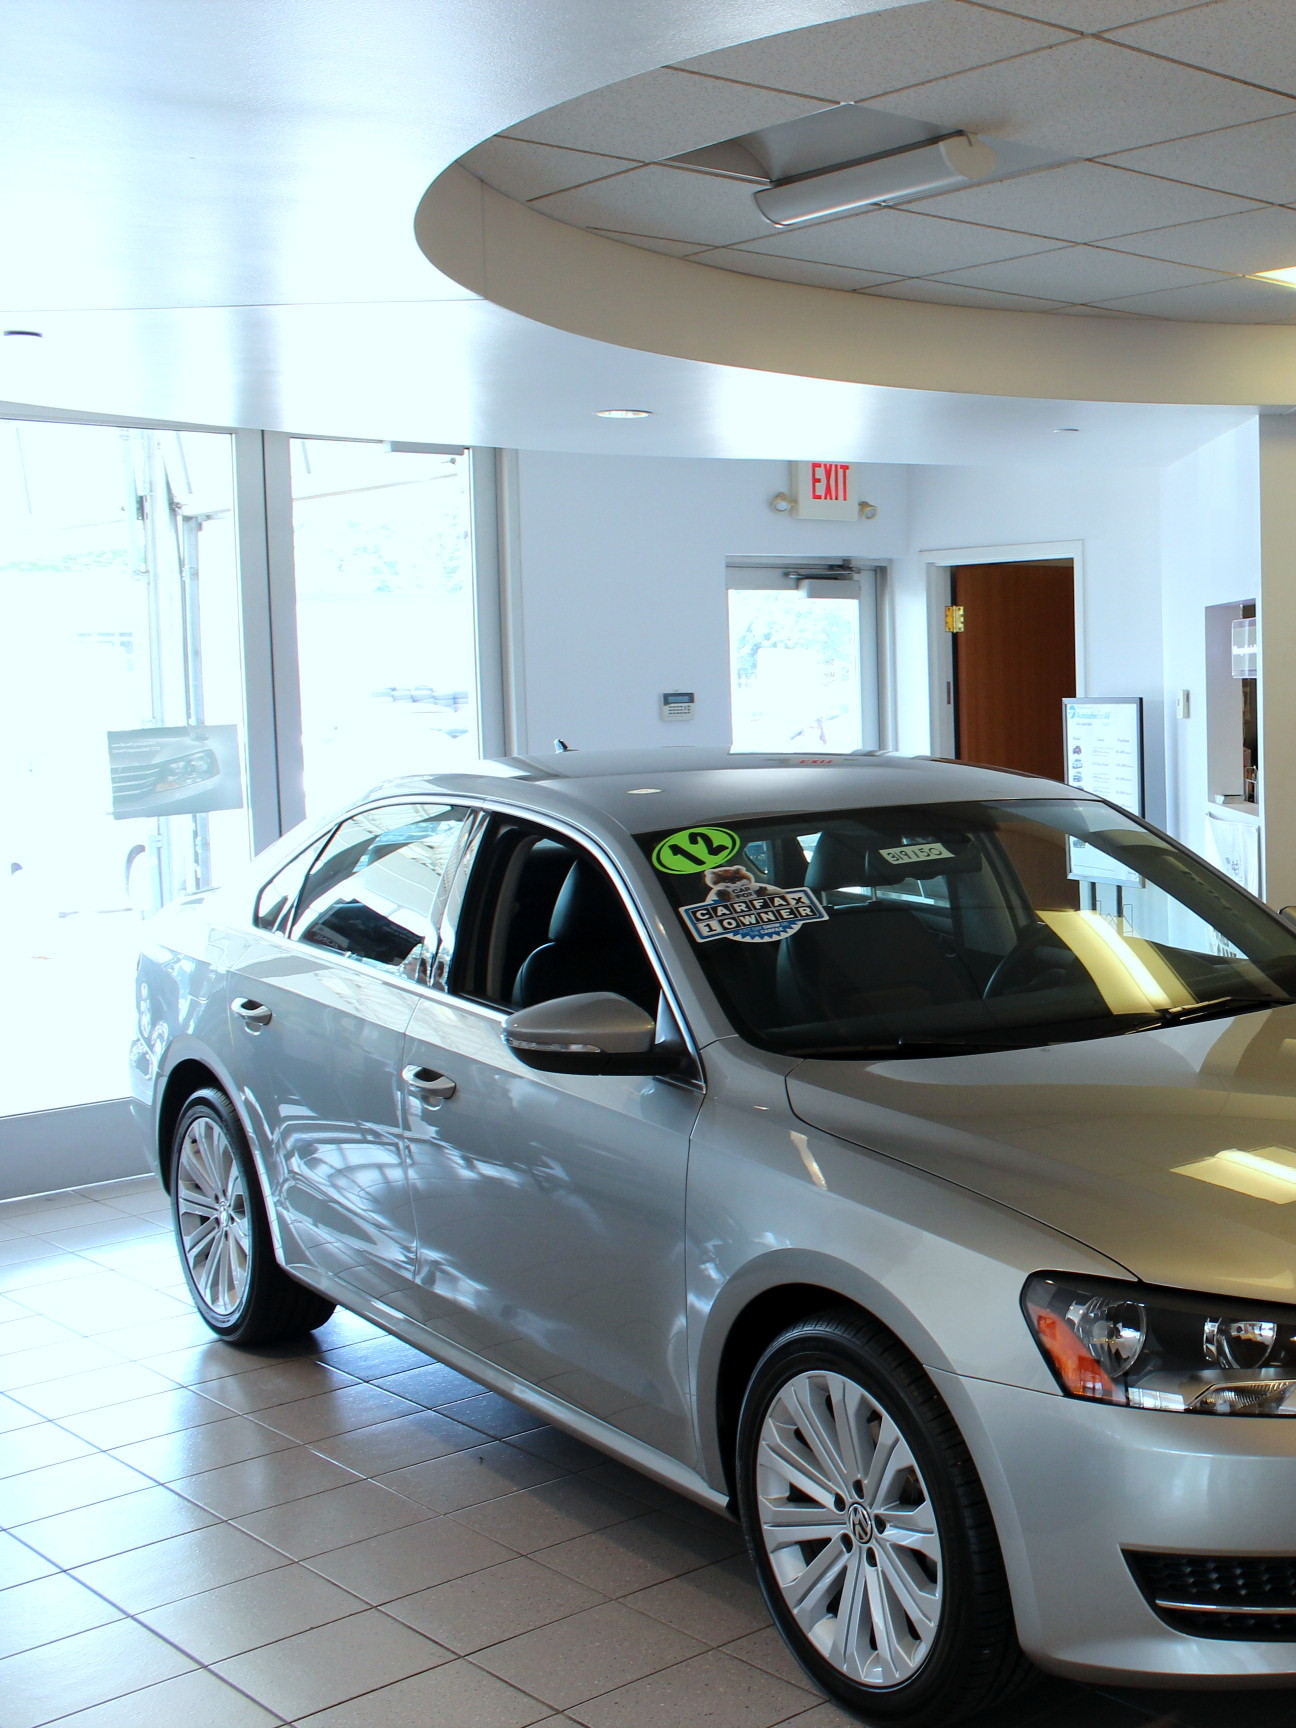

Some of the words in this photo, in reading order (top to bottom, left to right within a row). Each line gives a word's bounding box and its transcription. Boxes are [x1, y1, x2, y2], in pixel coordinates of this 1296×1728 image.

[812, 463, 849, 501] EXIT
[668, 832, 729, 866] 12
[695, 896, 806, 920] CARFAX
